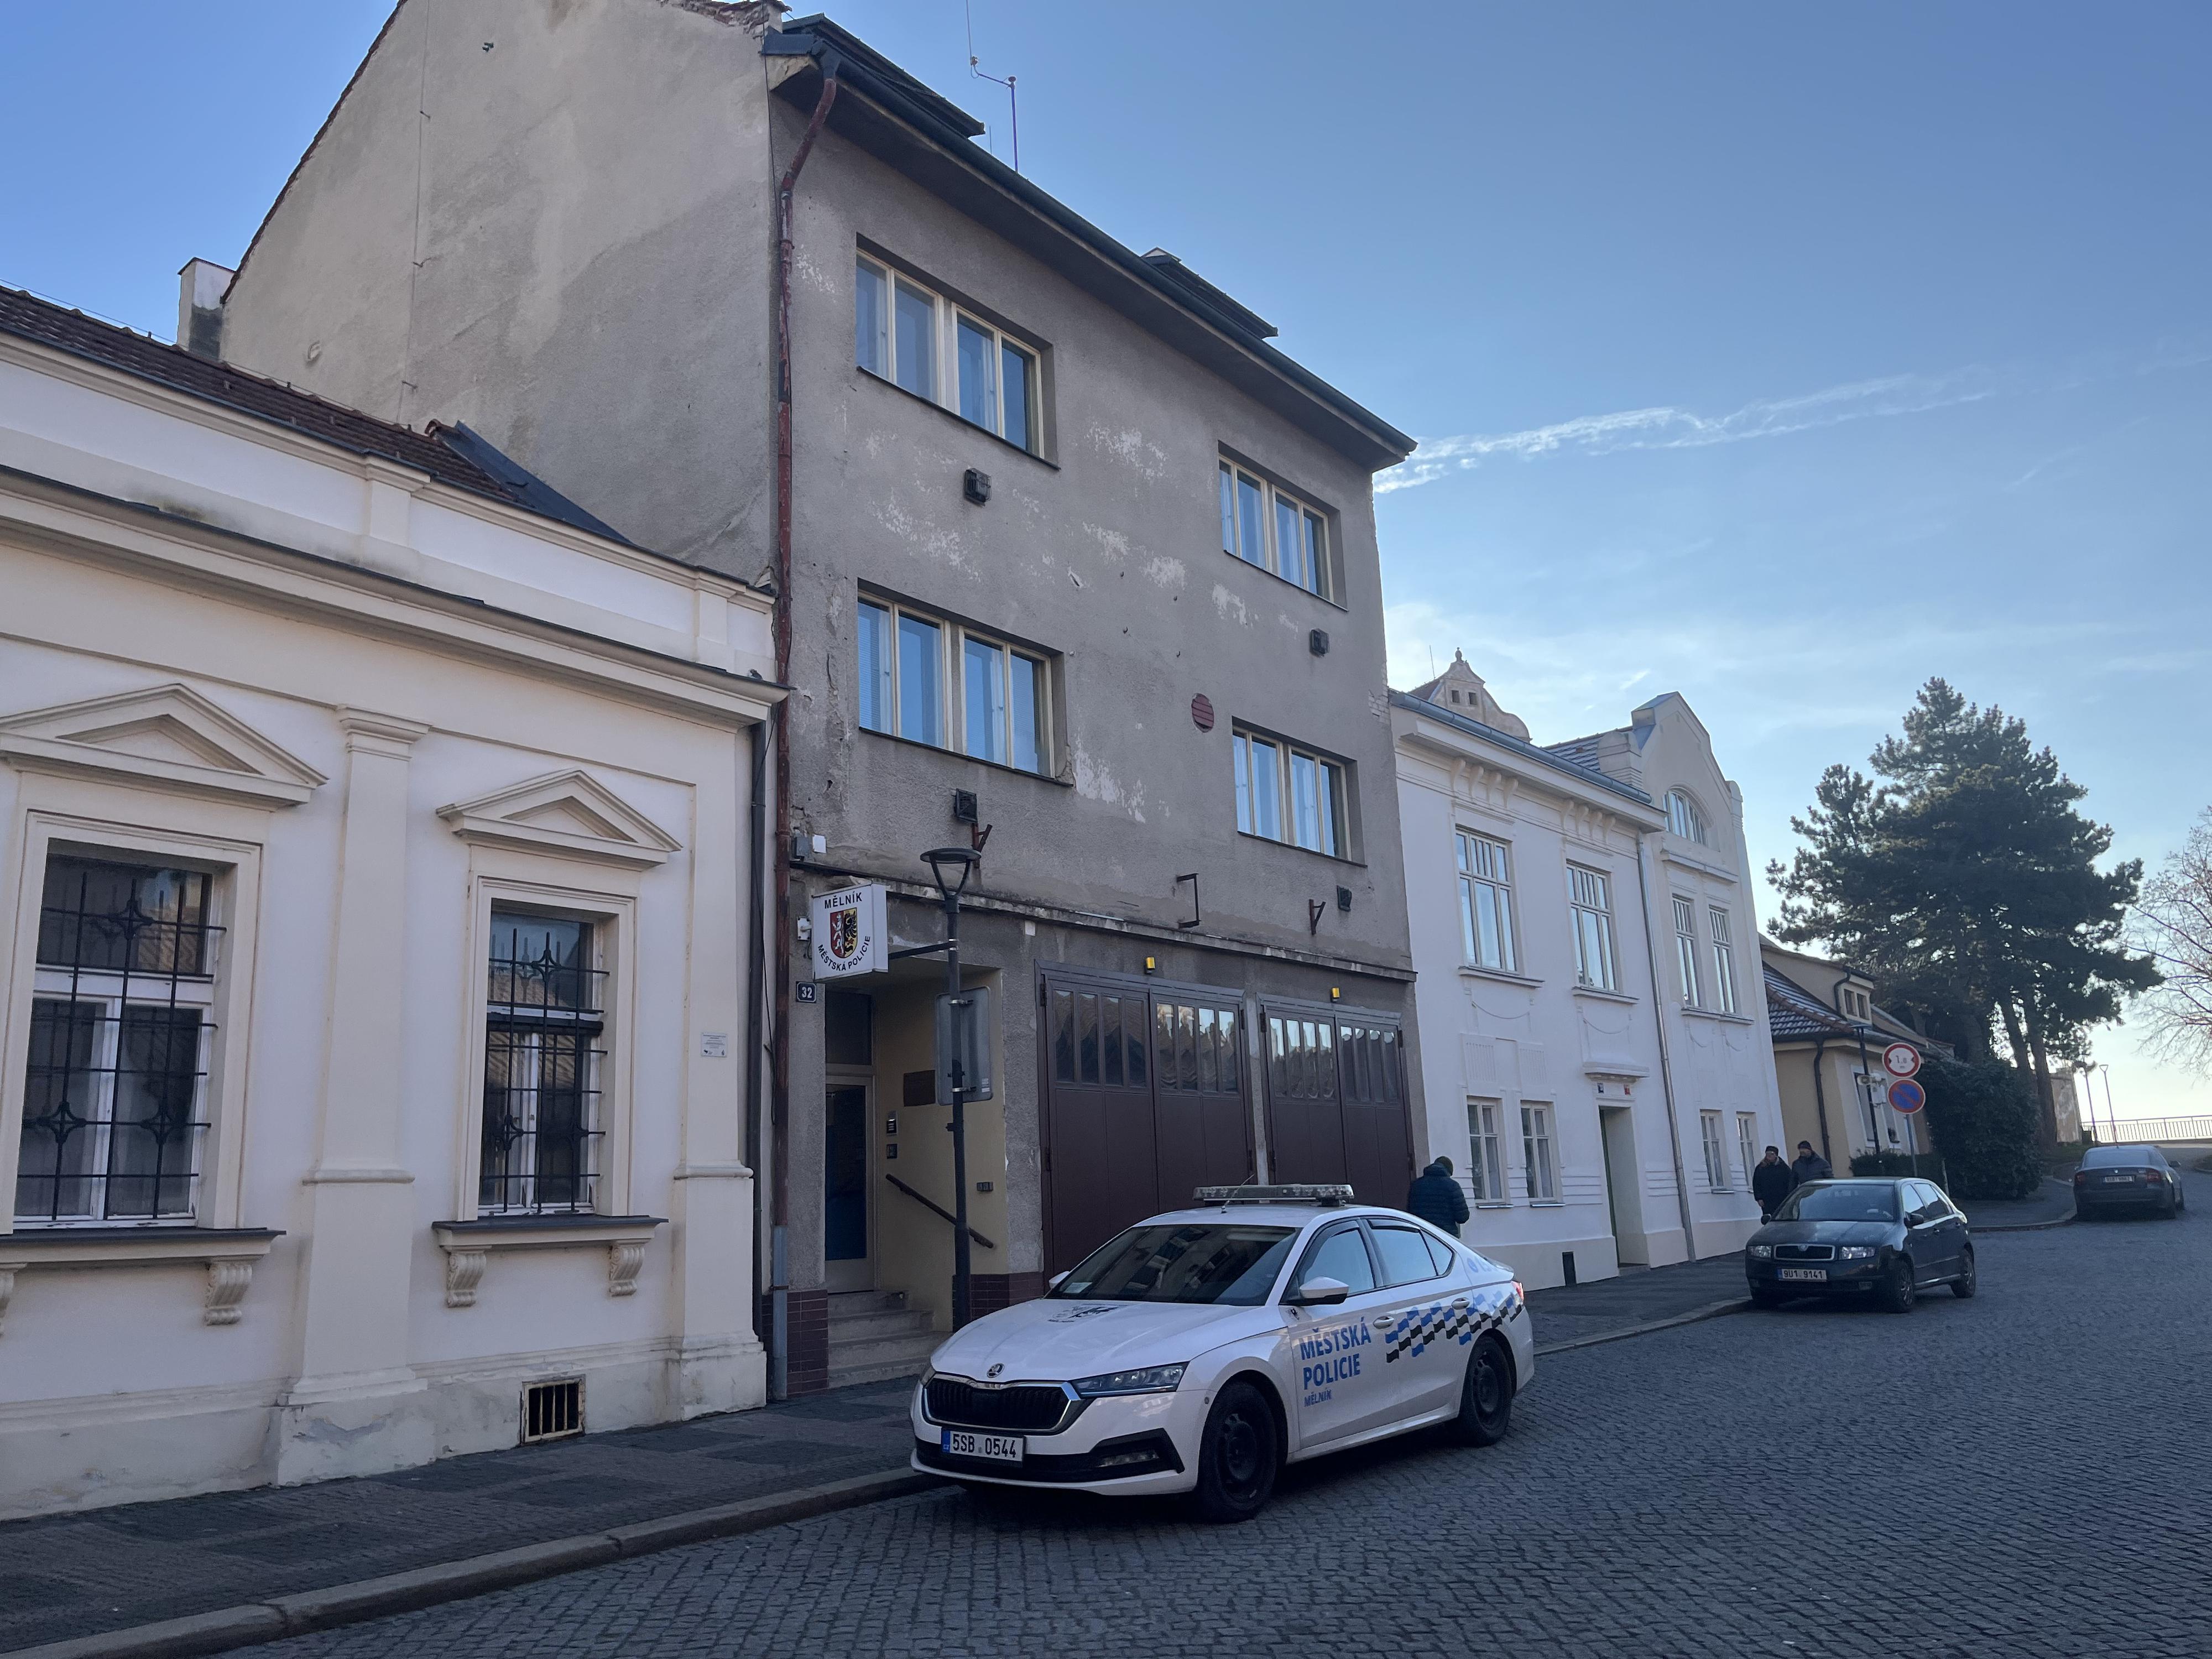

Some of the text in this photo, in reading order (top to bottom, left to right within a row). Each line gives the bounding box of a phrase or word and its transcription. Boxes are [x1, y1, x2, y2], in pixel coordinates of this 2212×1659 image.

[824, 891, 863, 909] MĚLNÍK
[817, 935, 871, 971] MĚSTSKÁ POLICIE
[801, 987, 813, 999] 32
[1783, 1270, 1823, 1279] 9U1 9141
[1300, 1316, 1371, 1360] MĚSTSKÁ
[1303, 1353, 1360, 1390] POLICIE
[1304, 1387, 1332, 1407] MĚLNÍK
[952, 1433, 1016, 1458] 5SB 0544
